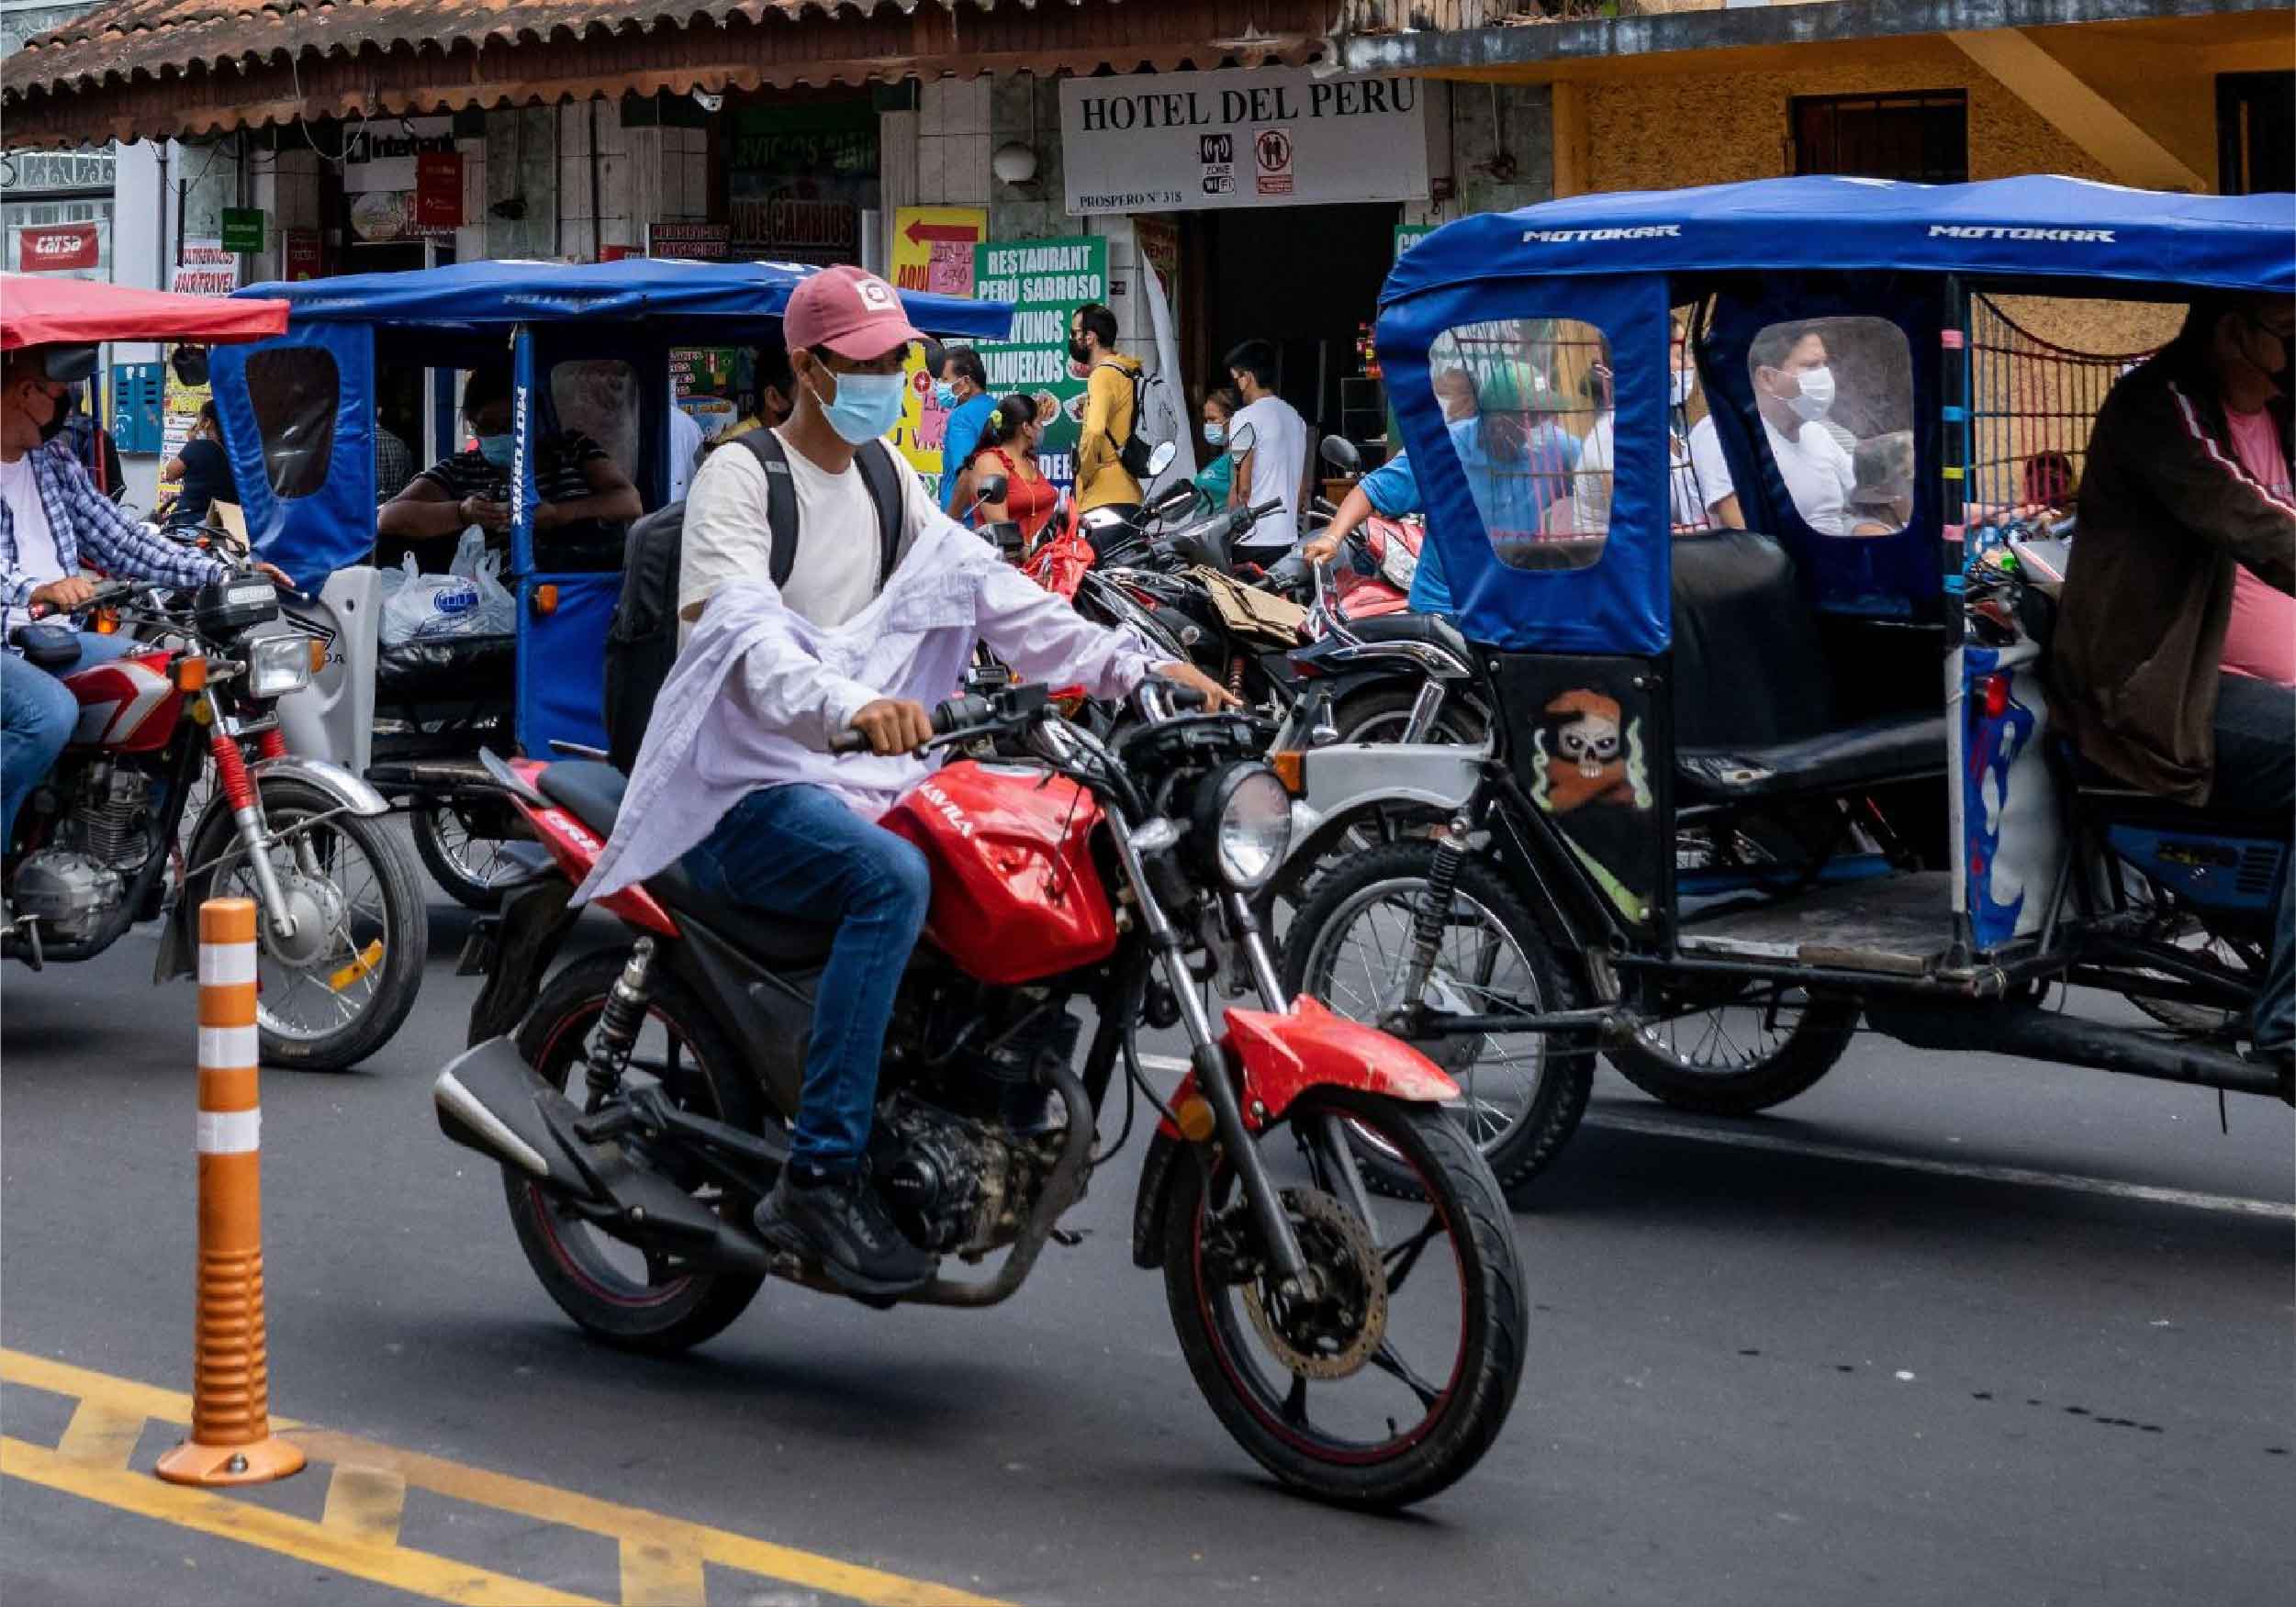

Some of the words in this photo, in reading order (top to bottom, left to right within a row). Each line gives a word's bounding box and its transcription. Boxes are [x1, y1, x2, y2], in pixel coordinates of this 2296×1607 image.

[1081, 92, 1210, 131] HOTEL
[1222, 86, 1298, 125] DEL
[1308, 76, 1416, 117] PERU
[1522, 224, 1682, 242] MOTOKAR
[1929, 225, 2116, 242] MOTOKAR
[988, 246, 1092, 274] RESTAURANT
[979, 274, 1019, 304] PERÚ
[1023, 273, 1101, 302] SABROSO
